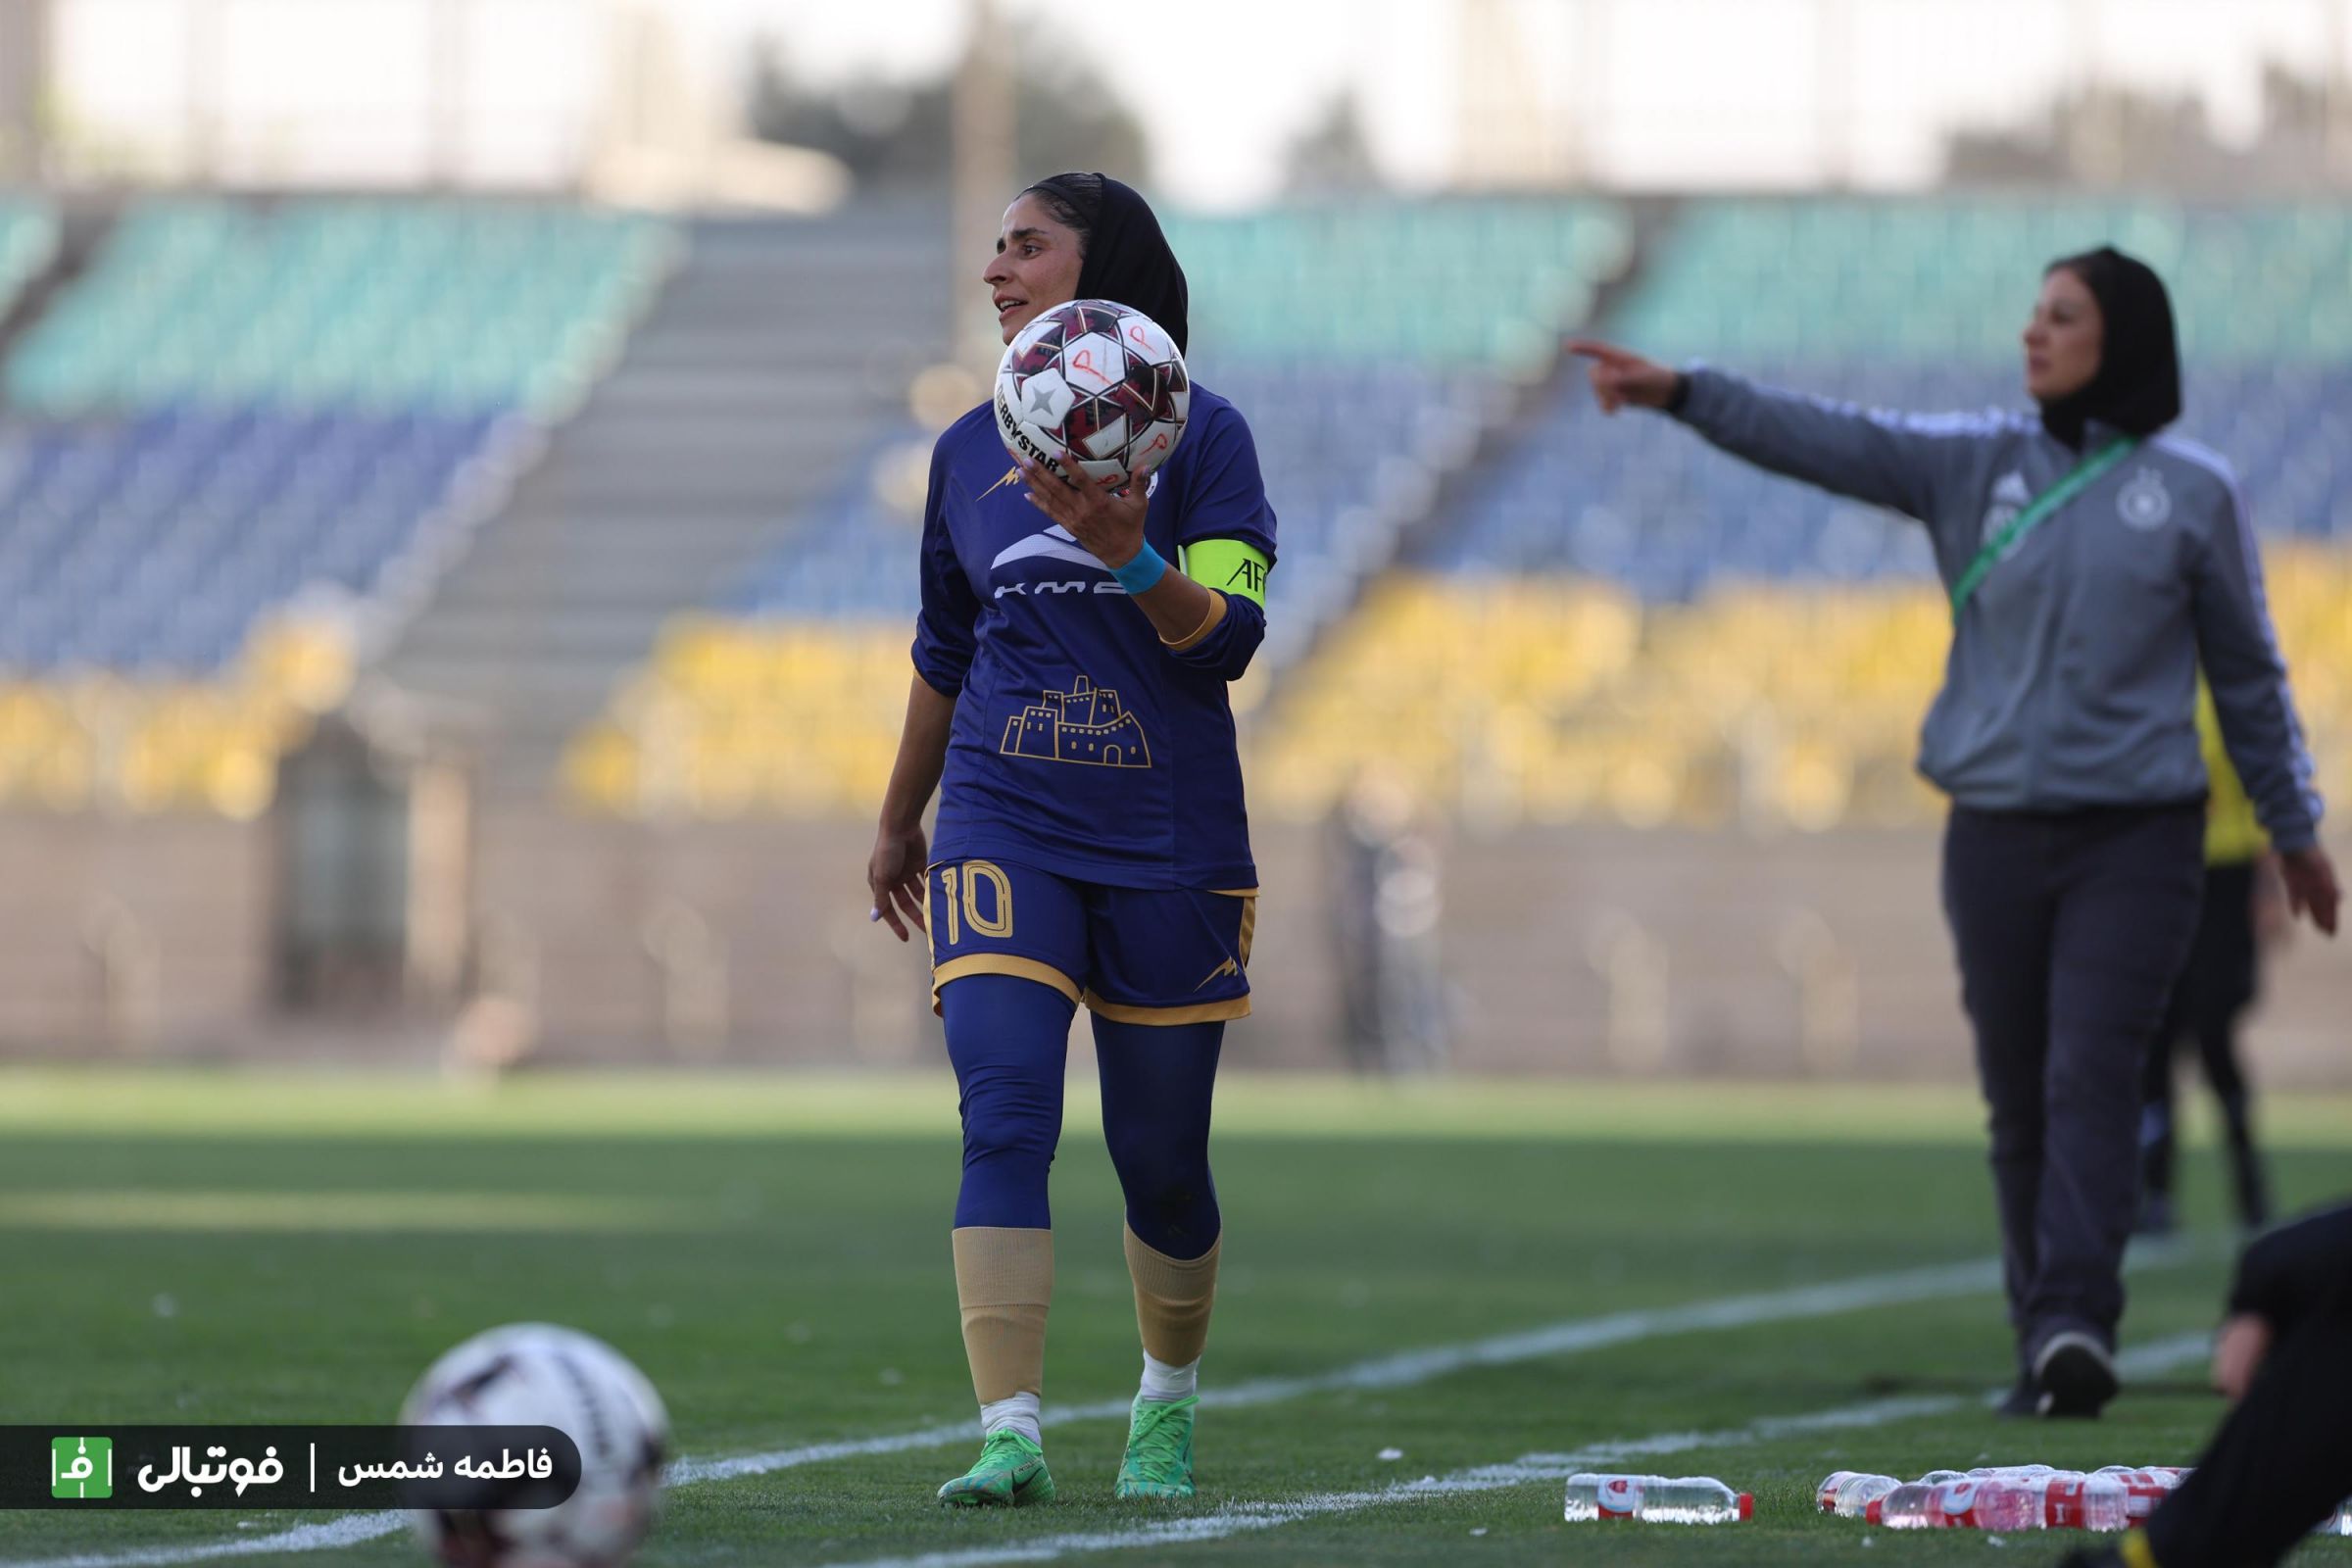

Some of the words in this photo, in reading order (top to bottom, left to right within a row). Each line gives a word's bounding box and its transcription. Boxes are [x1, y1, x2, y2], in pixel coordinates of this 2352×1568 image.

[996, 383, 1059, 472] DERBYSTAR
[1226, 558, 1267, 594] AF
[941, 859, 1013, 946] 10
